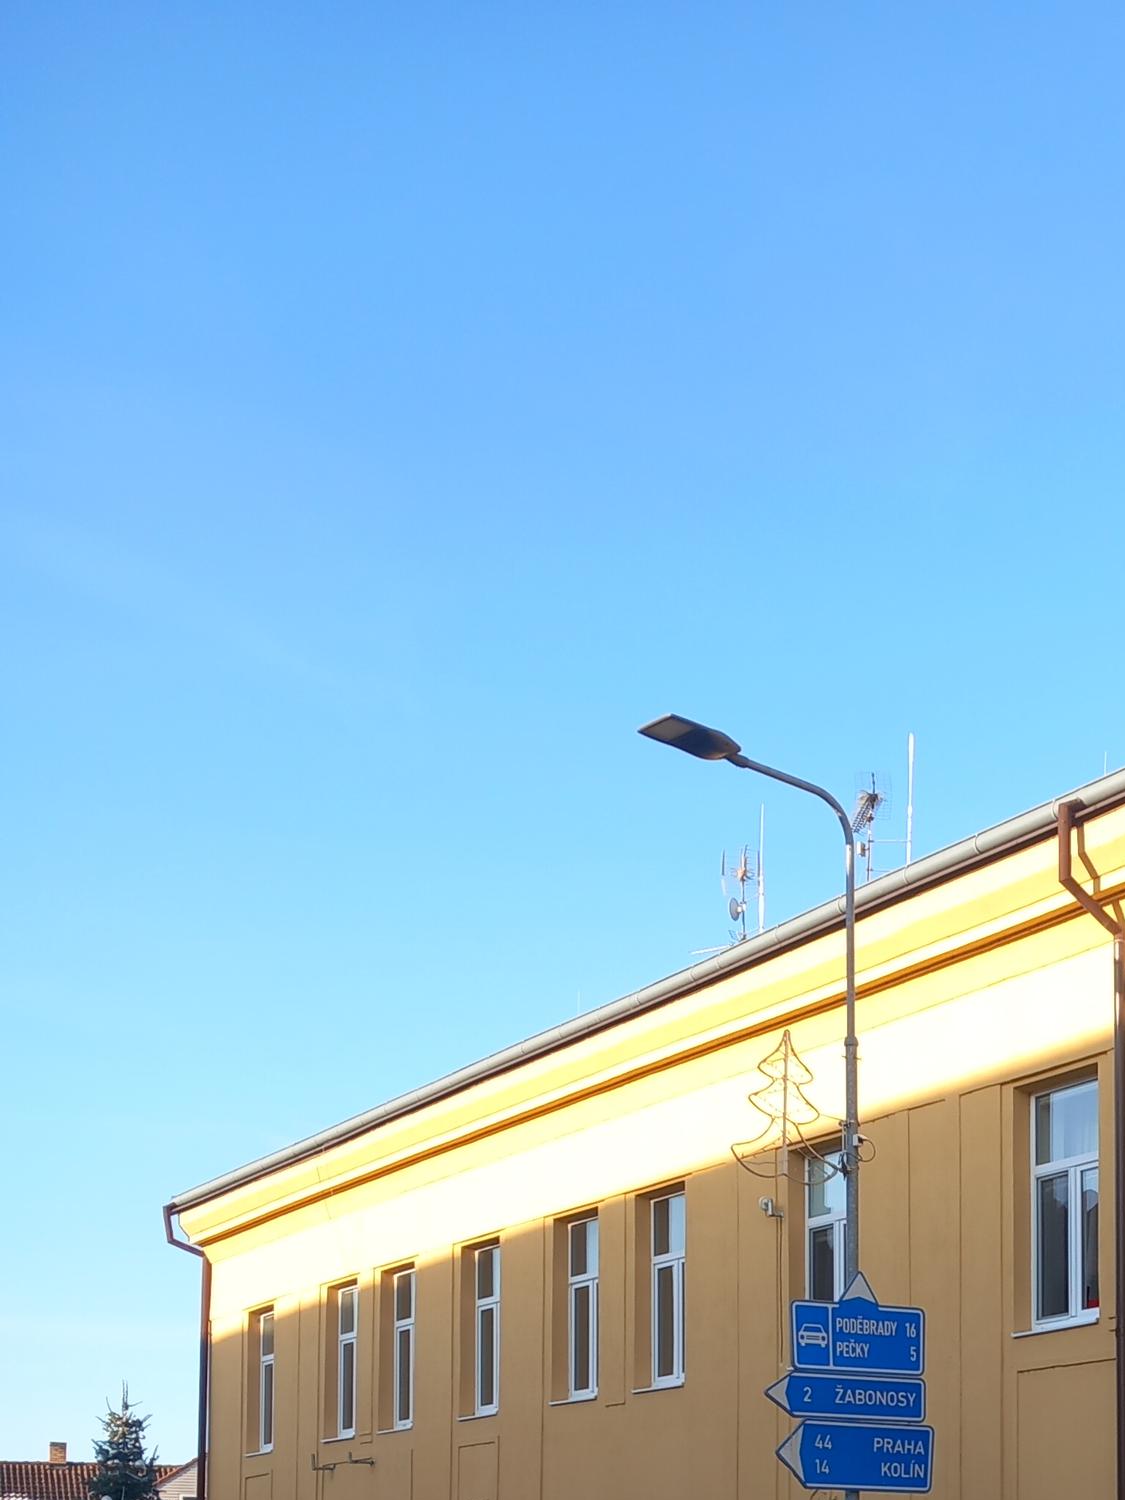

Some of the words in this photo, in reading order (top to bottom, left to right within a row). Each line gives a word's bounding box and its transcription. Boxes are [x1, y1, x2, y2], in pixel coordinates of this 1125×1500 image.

[836, 1315, 897, 1336] PODĚBRADY
[905, 1322, 917, 1338] 16
[836, 1339, 869, 1358] PEČKY
[909, 1346, 917, 1361] 5
[803, 1386, 812, 1402] 2
[835, 1385, 916, 1407] ŽABONOSY
[814, 1434, 832, 1450] 44
[873, 1437, 925, 1455] PRAHA
[815, 1458, 830, 1475] 14
[881, 1459, 925, 1479] KOLÍN
